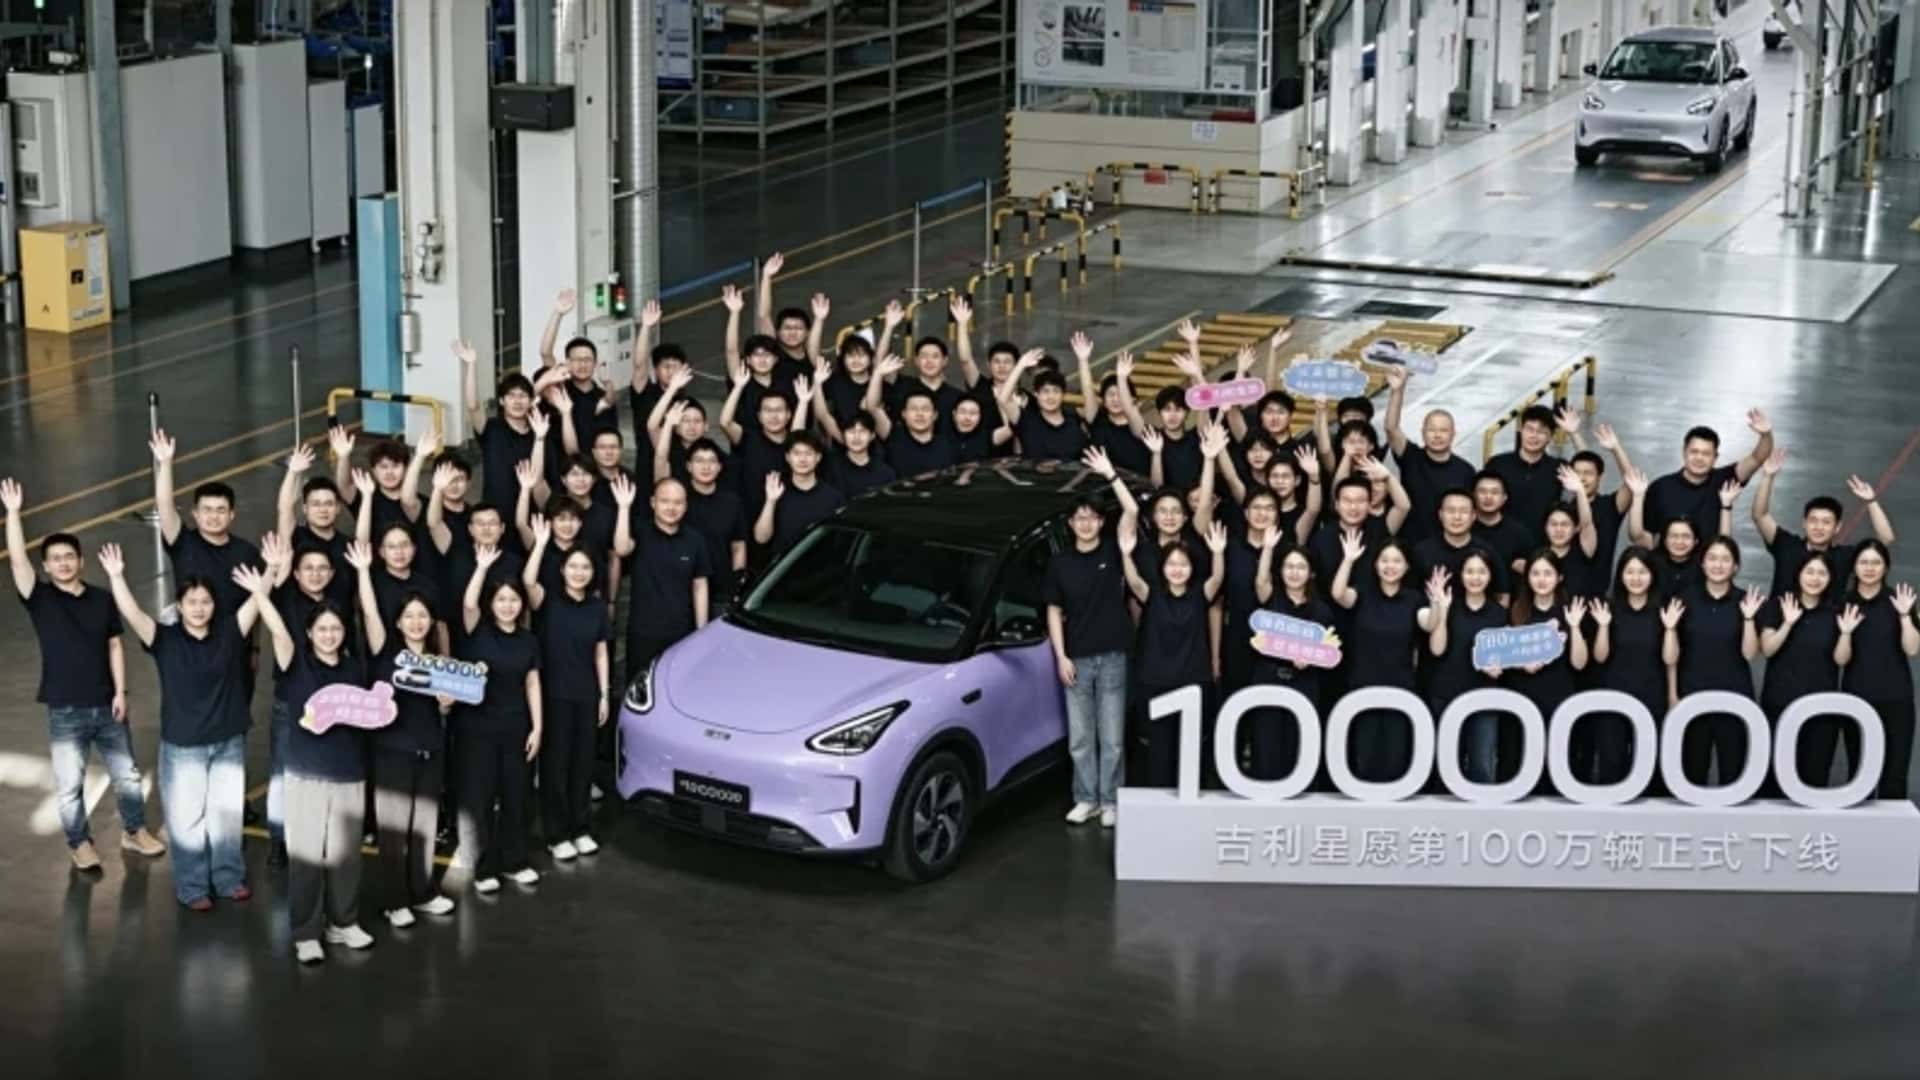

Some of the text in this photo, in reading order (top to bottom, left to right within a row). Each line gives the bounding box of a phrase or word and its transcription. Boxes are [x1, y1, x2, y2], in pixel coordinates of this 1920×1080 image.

[1149, 684, 1886, 809] 1000000
[1215, 823, 1841, 873] 吉利星愿第100万辆正式下线
